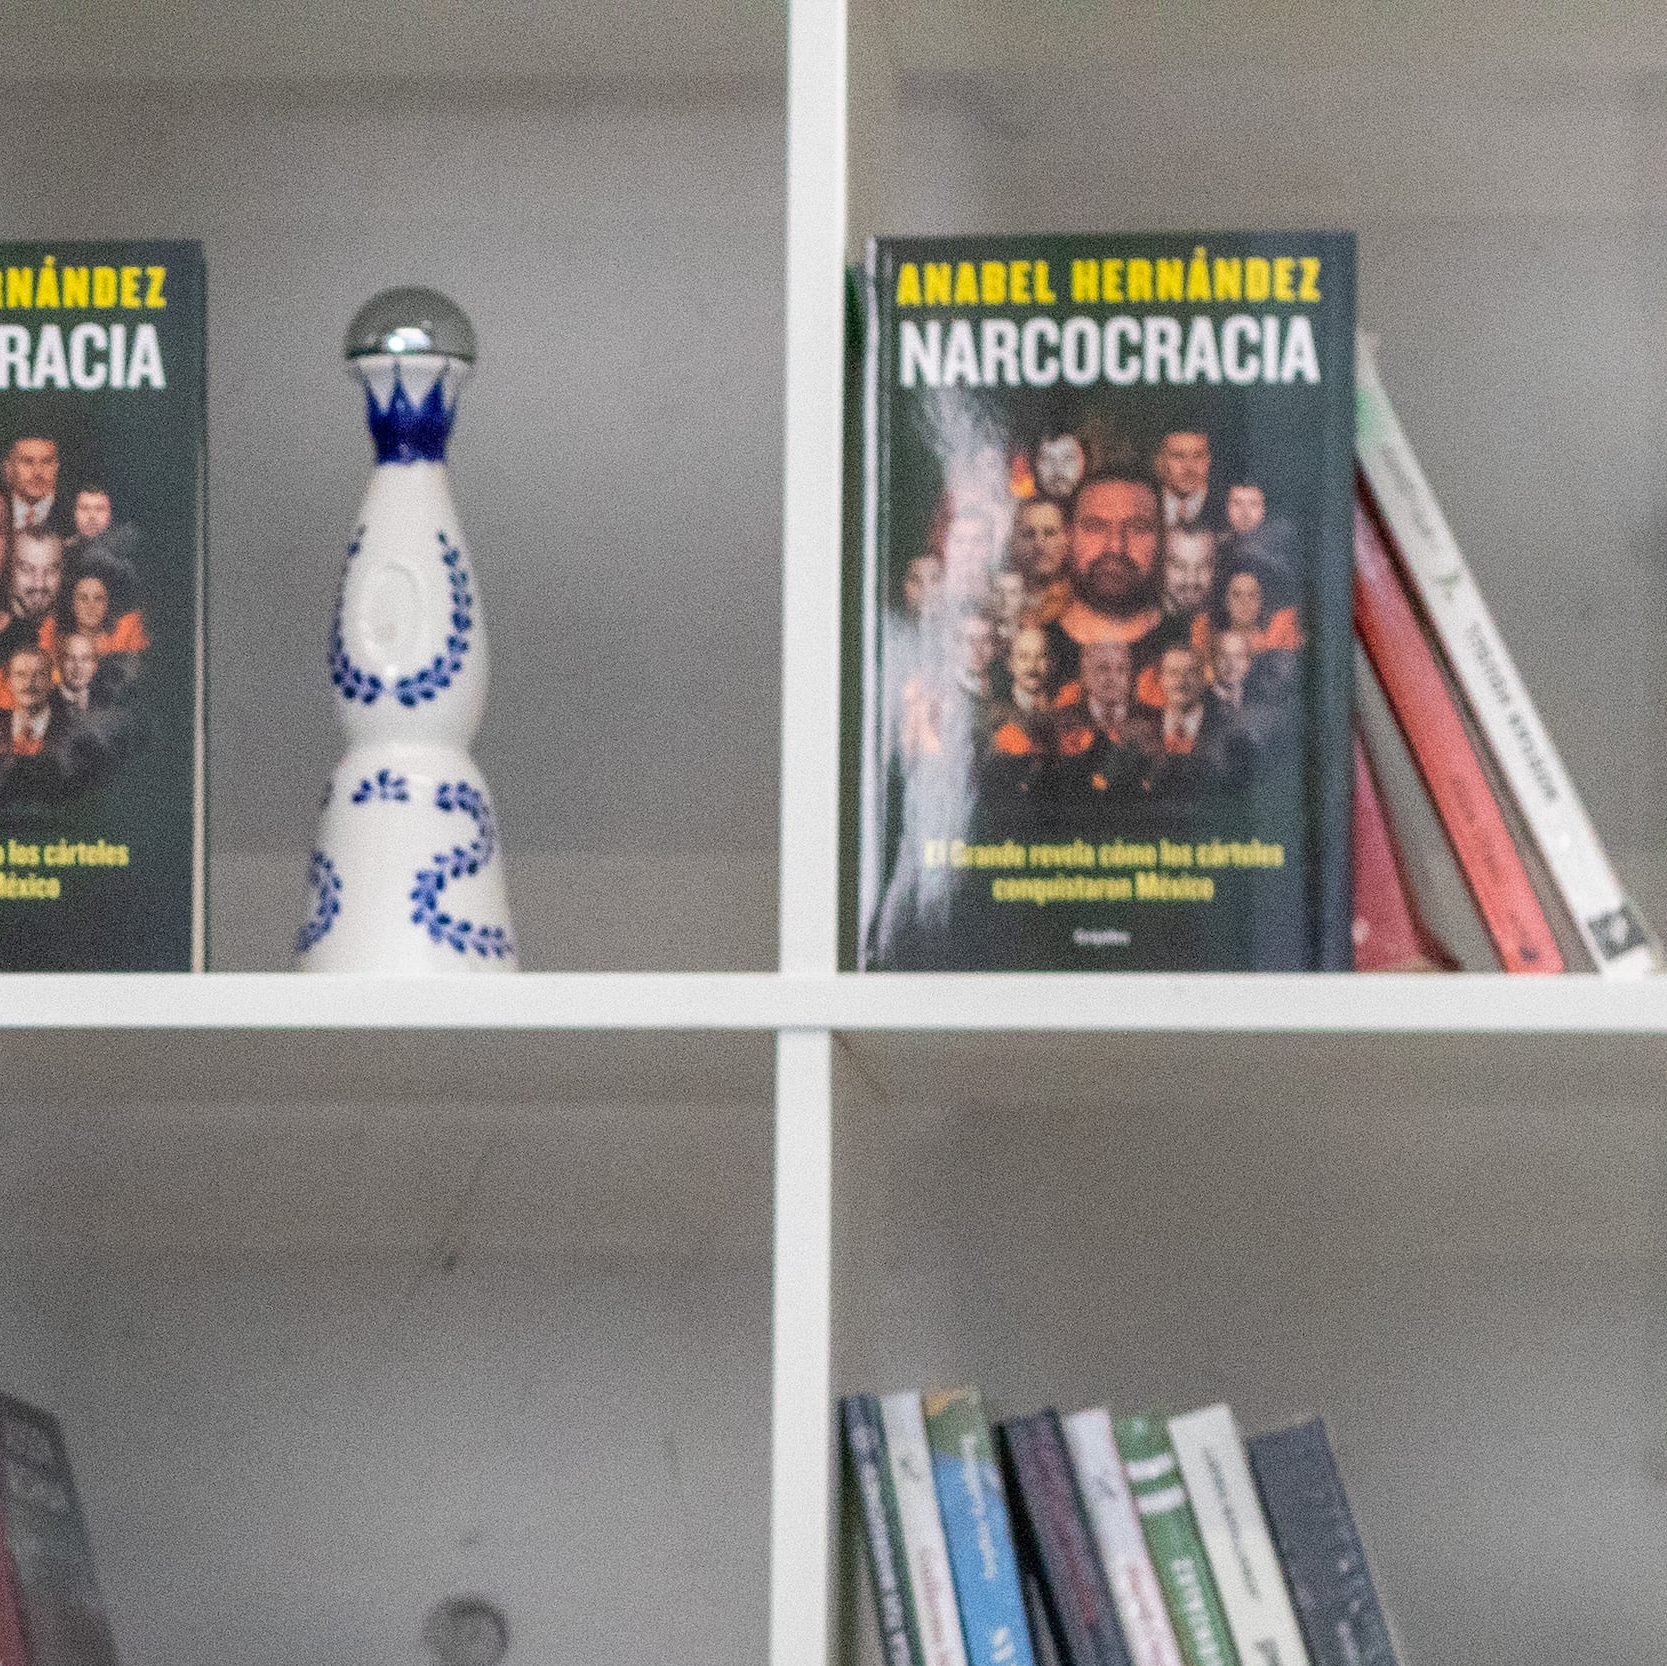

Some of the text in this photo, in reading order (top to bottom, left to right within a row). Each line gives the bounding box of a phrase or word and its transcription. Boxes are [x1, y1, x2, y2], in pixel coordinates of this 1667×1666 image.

[897, 248, 1322, 306] ANABEL HERNÁNDEZ
[898, 314, 1322, 386] NARCOCRACIA
